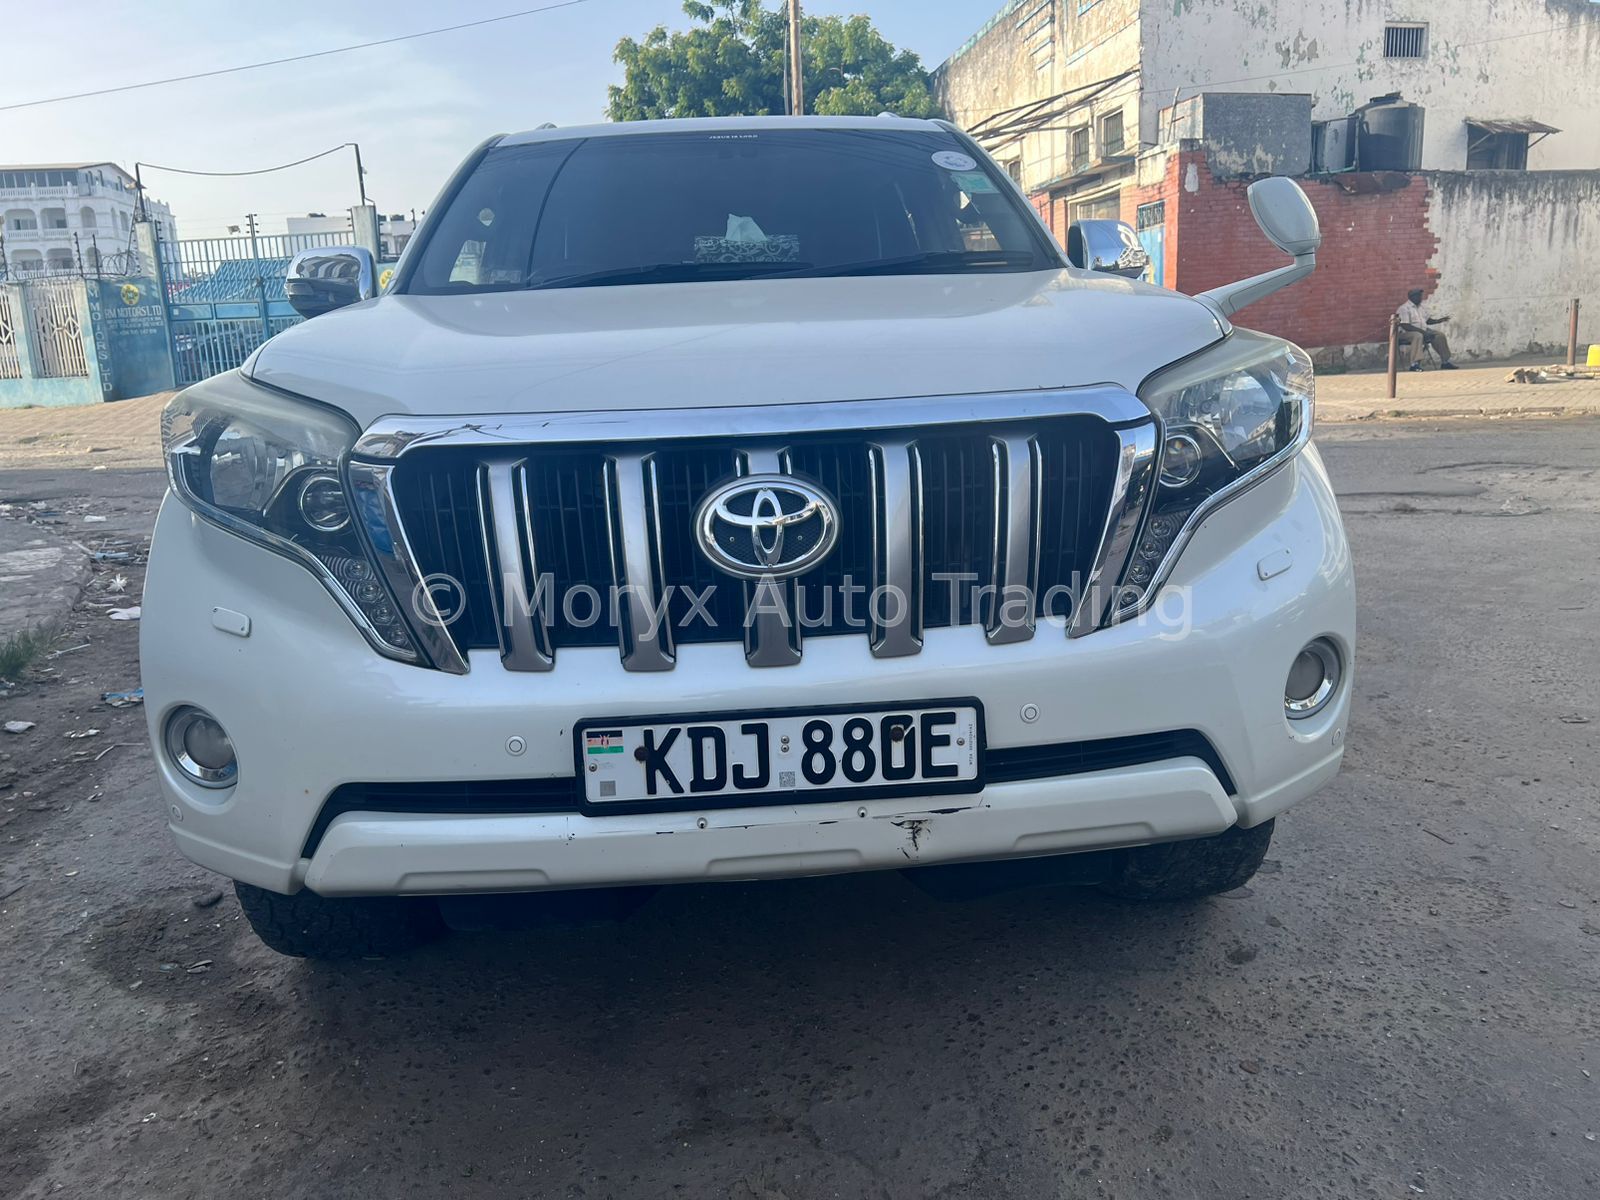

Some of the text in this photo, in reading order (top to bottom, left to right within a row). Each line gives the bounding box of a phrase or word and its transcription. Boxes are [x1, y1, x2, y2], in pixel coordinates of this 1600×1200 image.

[117, 306, 146, 318] MOTORS
[146, 305, 162, 316] LTD
[643, 711, 959, 795] KDJ 880E
